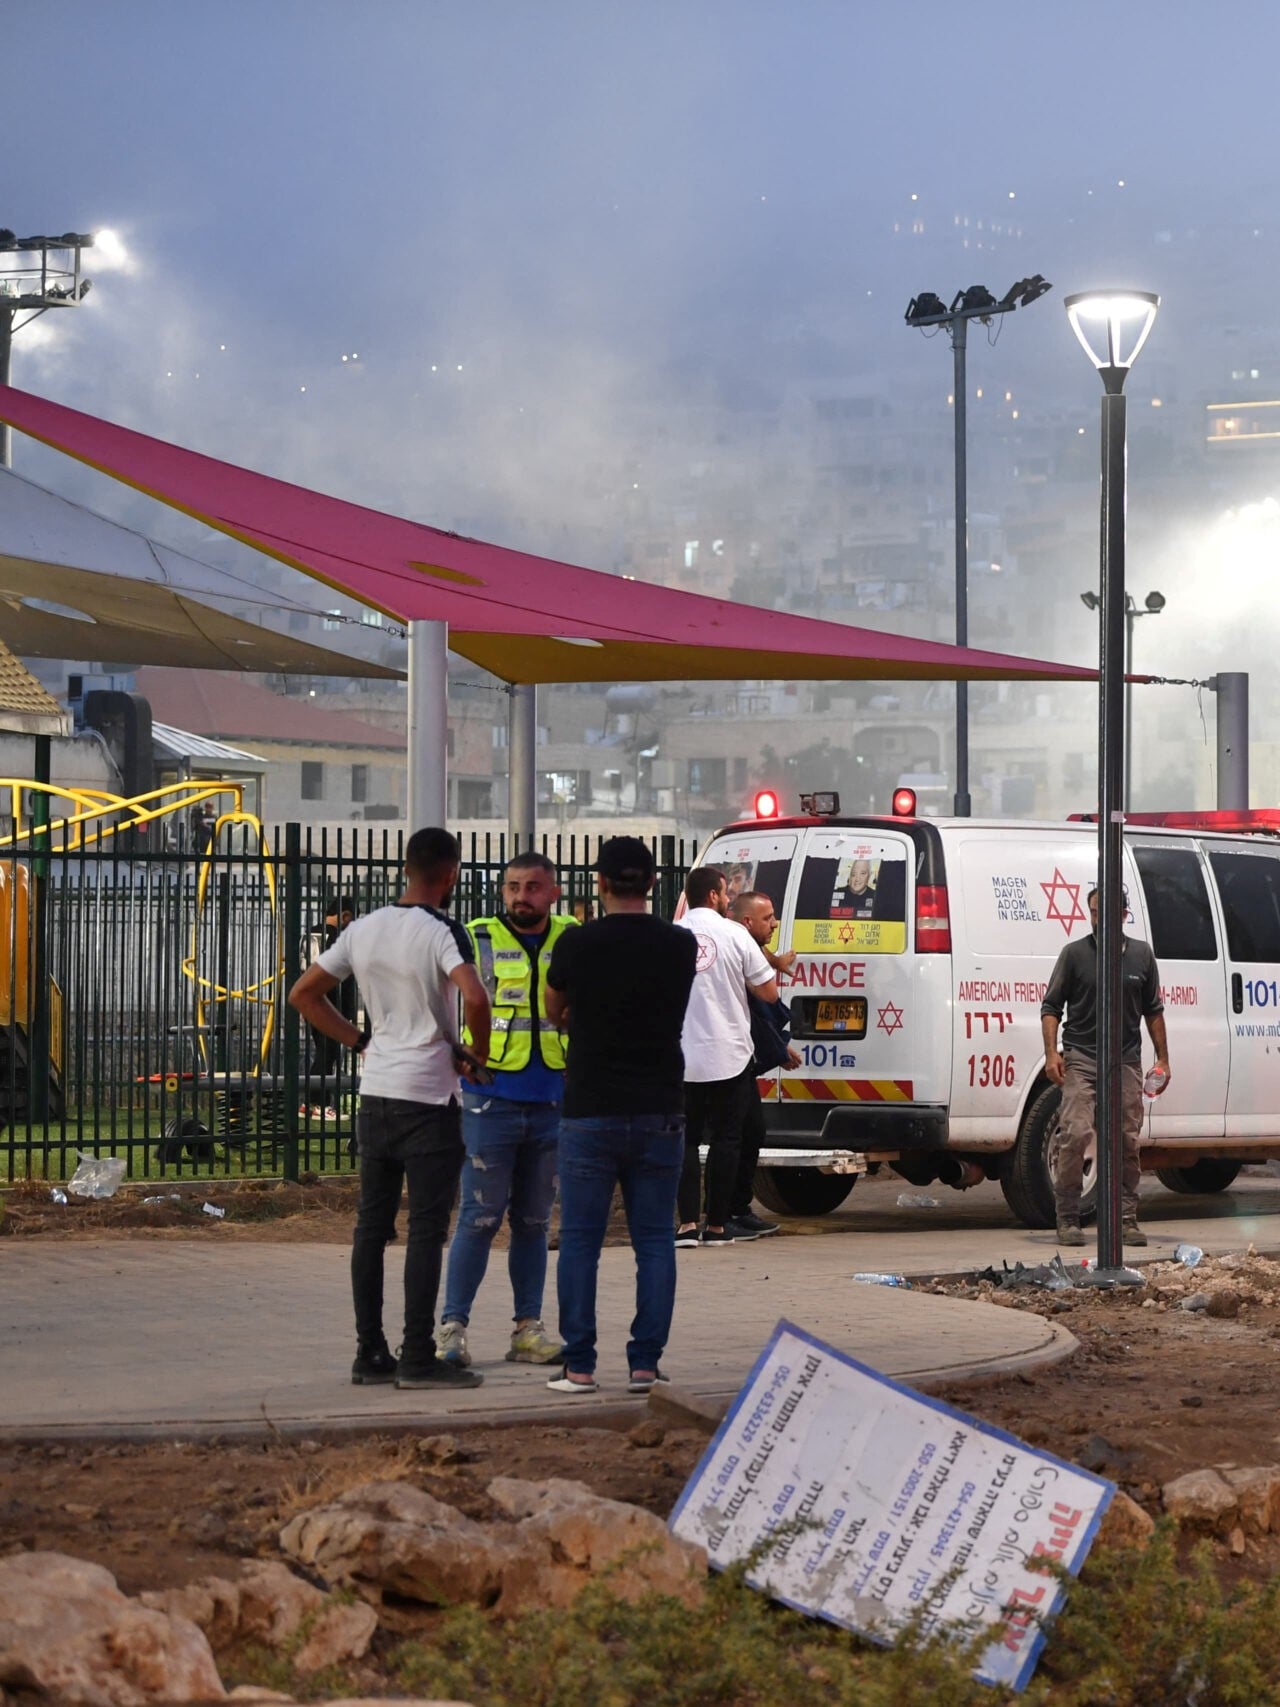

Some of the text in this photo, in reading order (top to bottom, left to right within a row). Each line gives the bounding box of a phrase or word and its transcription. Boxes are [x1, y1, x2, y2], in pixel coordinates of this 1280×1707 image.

[992, 877, 1027, 888] MAGEN
[994, 888, 1024, 899] DAVID
[998, 900, 1027, 910] ADOM
[998, 911, 1042, 922] IN ISRAEL
[495, 951, 522, 960] POLICE
[775, 962, 866, 988] LANCE
[959, 981, 1198, 1005] AMERICAN FRIEND M-ARMDI
[1245, 980, 1278, 1007] 101
[964, 1012, 1014, 1039] ירדן
[801, 1045, 837, 1067] 101
[968, 1054, 1015, 1087] 1306
[741, 1365, 790, 1442] 054-6336229
[929, 1481, 975, 1557] 054-4213045
